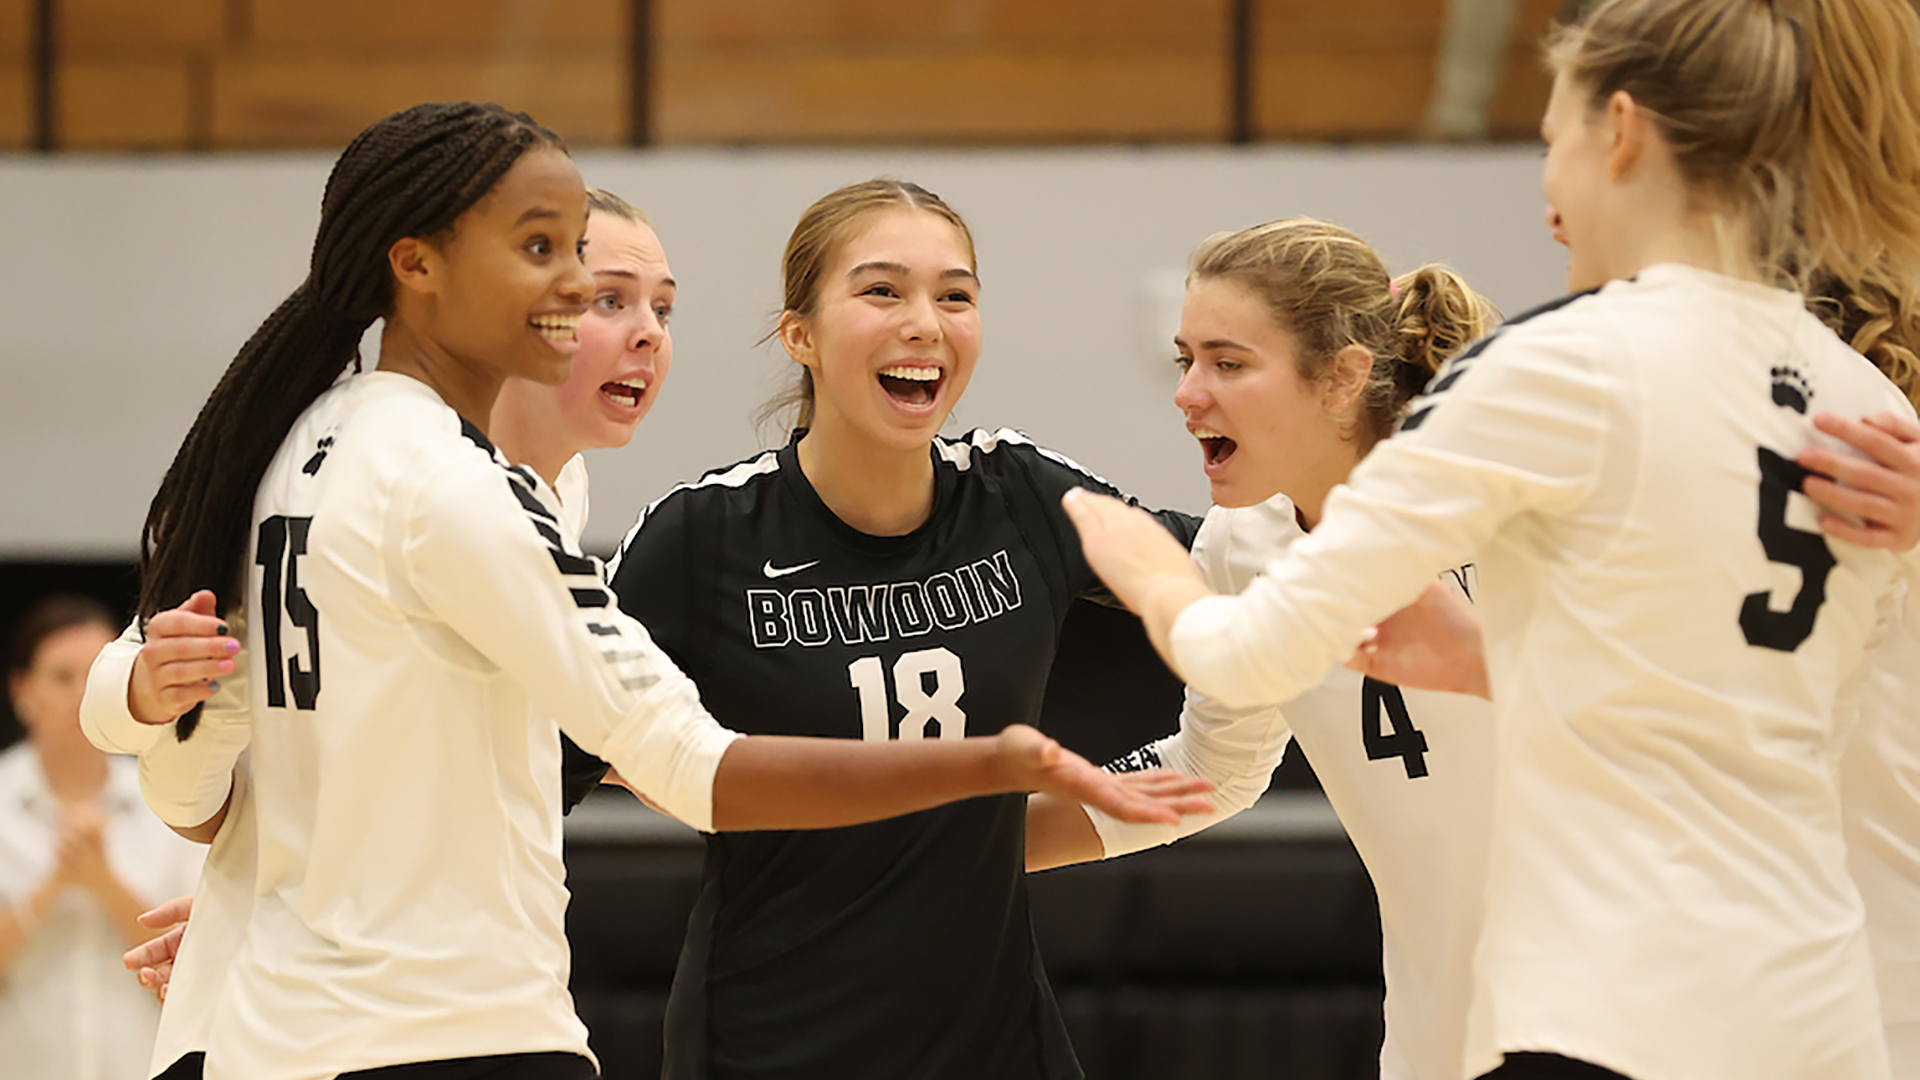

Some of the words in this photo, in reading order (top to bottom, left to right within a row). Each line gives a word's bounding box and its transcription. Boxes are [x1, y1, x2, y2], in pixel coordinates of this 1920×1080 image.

[746, 550, 1023, 649] BOWDOIN
[1738, 446, 1838, 653] 5
[255, 514, 322, 712] 15
[847, 646, 968, 743] 18
[1361, 674, 1429, 779] 4
